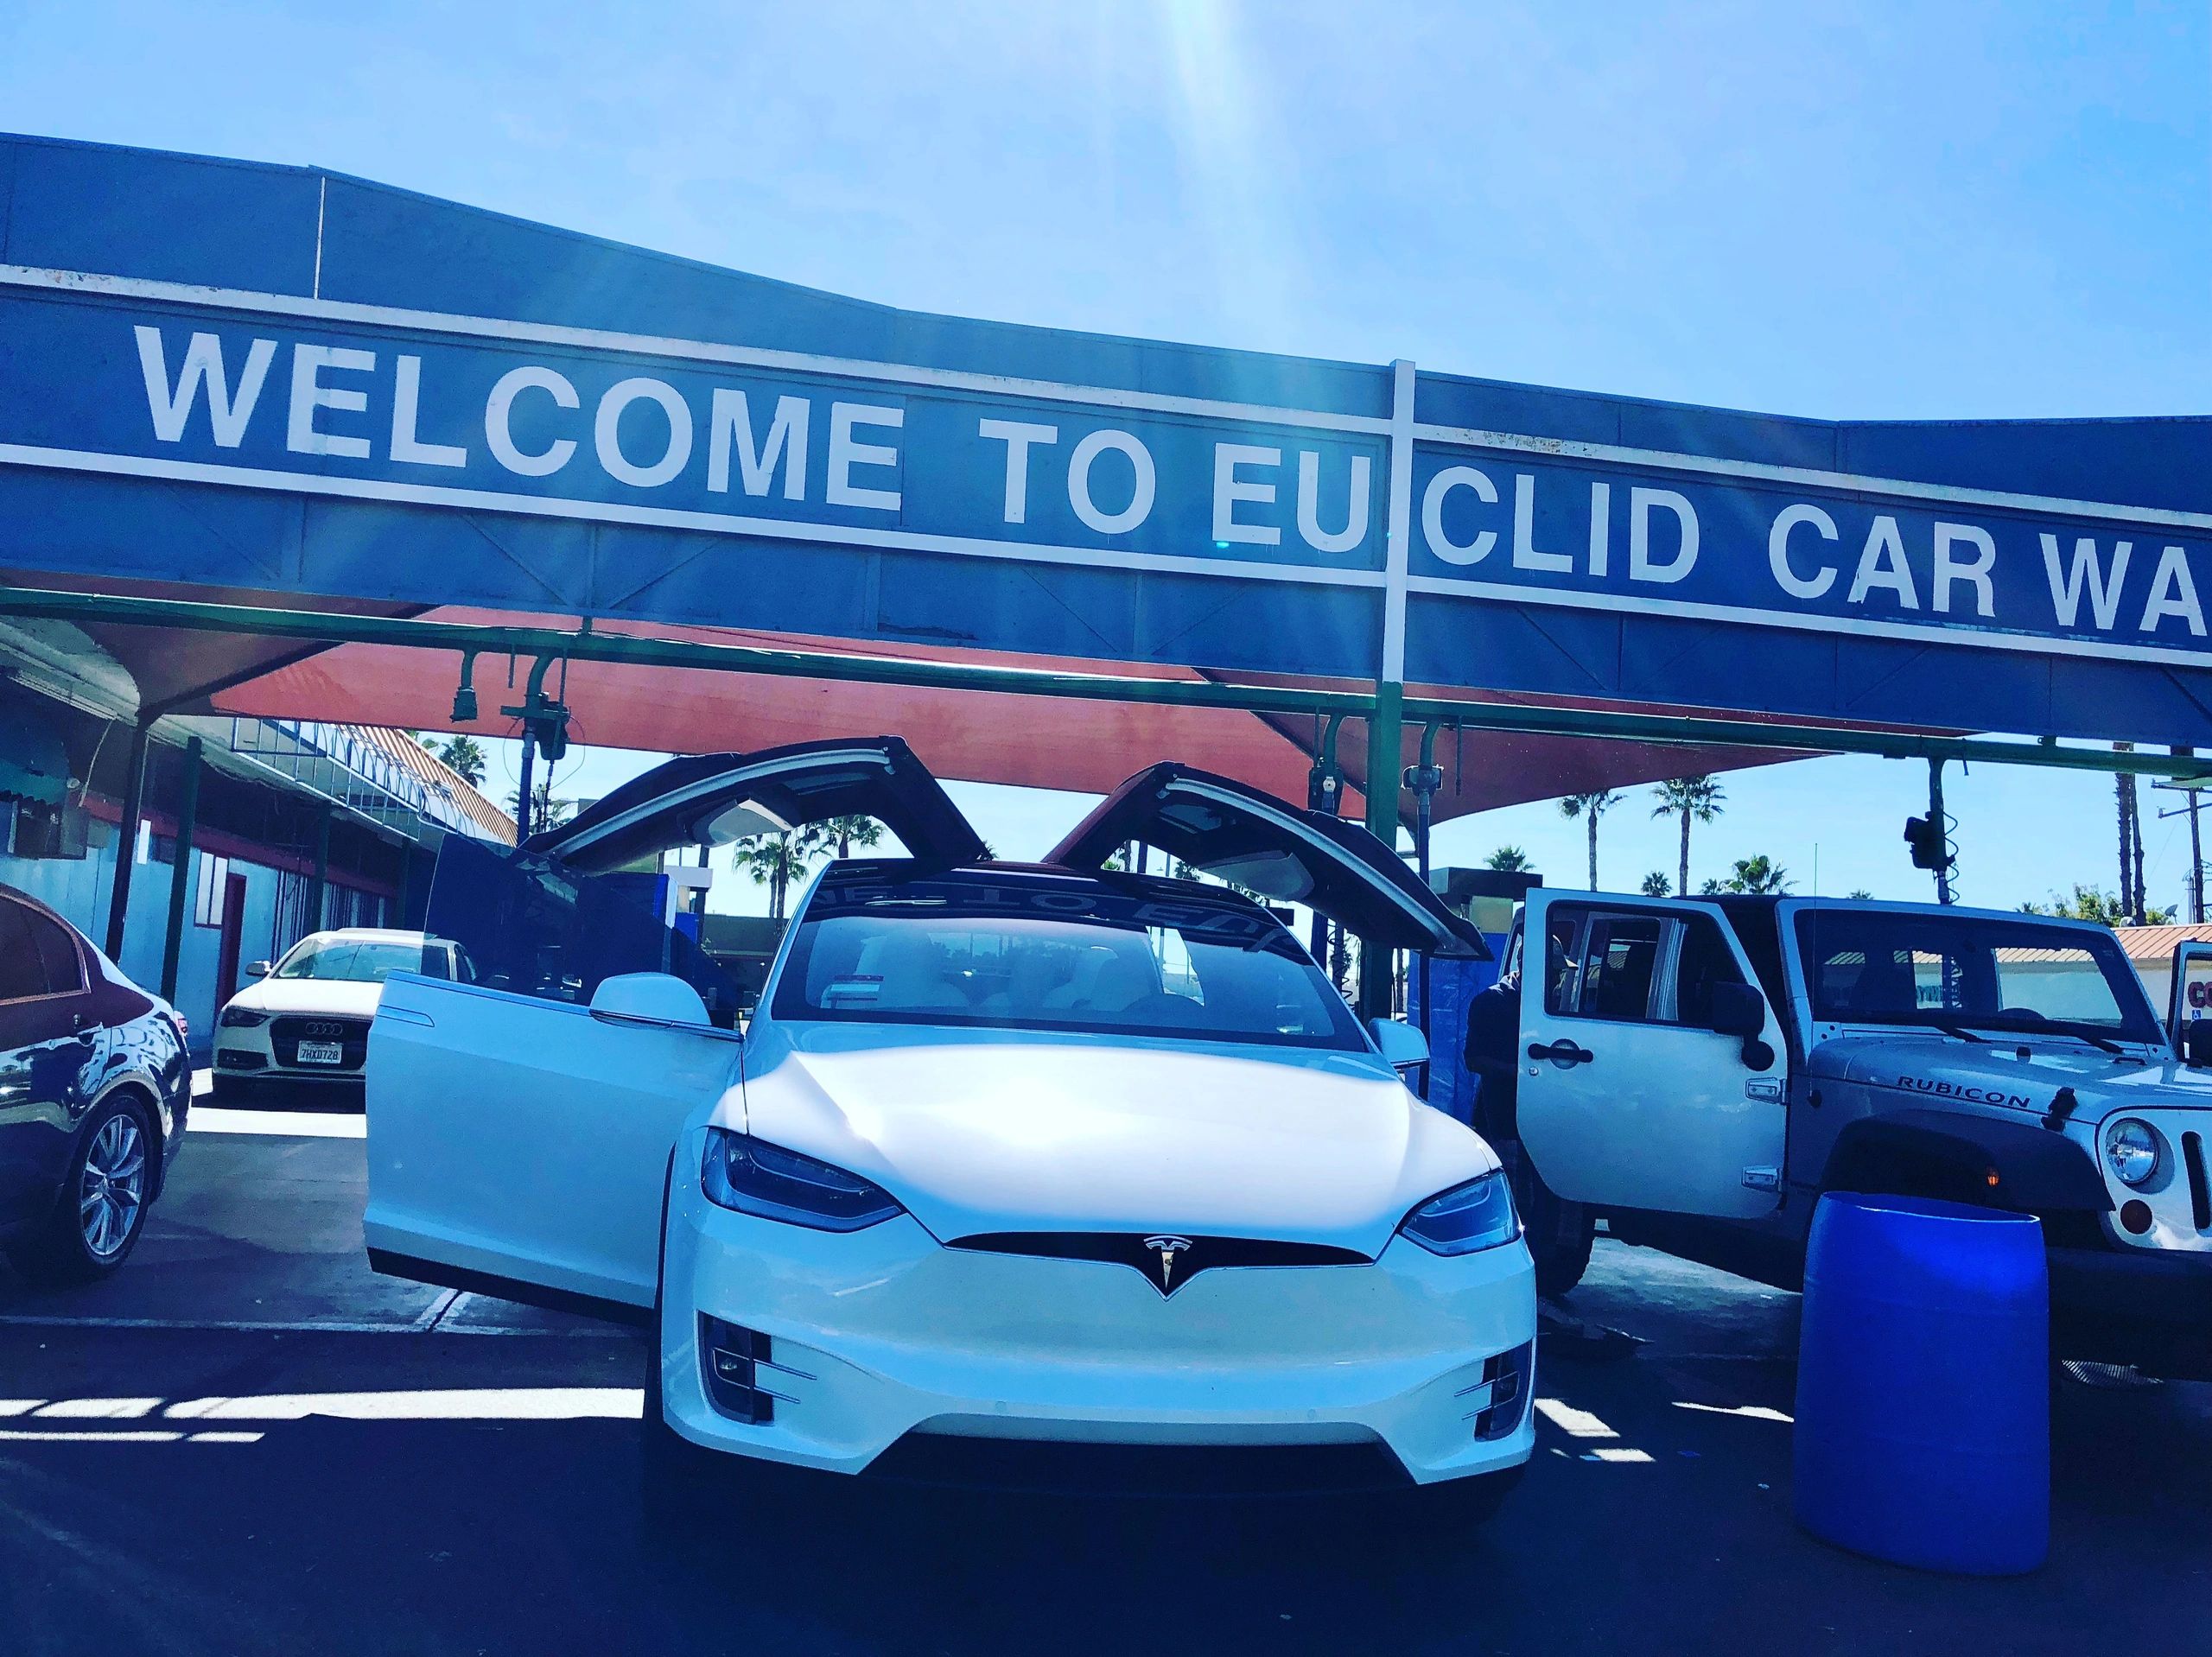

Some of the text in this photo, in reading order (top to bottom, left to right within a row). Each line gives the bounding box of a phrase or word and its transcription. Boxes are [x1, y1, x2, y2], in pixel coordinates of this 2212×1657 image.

[134, 325, 2209, 637] WELCOME TO EUCLID CAR WA
[1897, 1076, 2031, 1108] RUBICON
